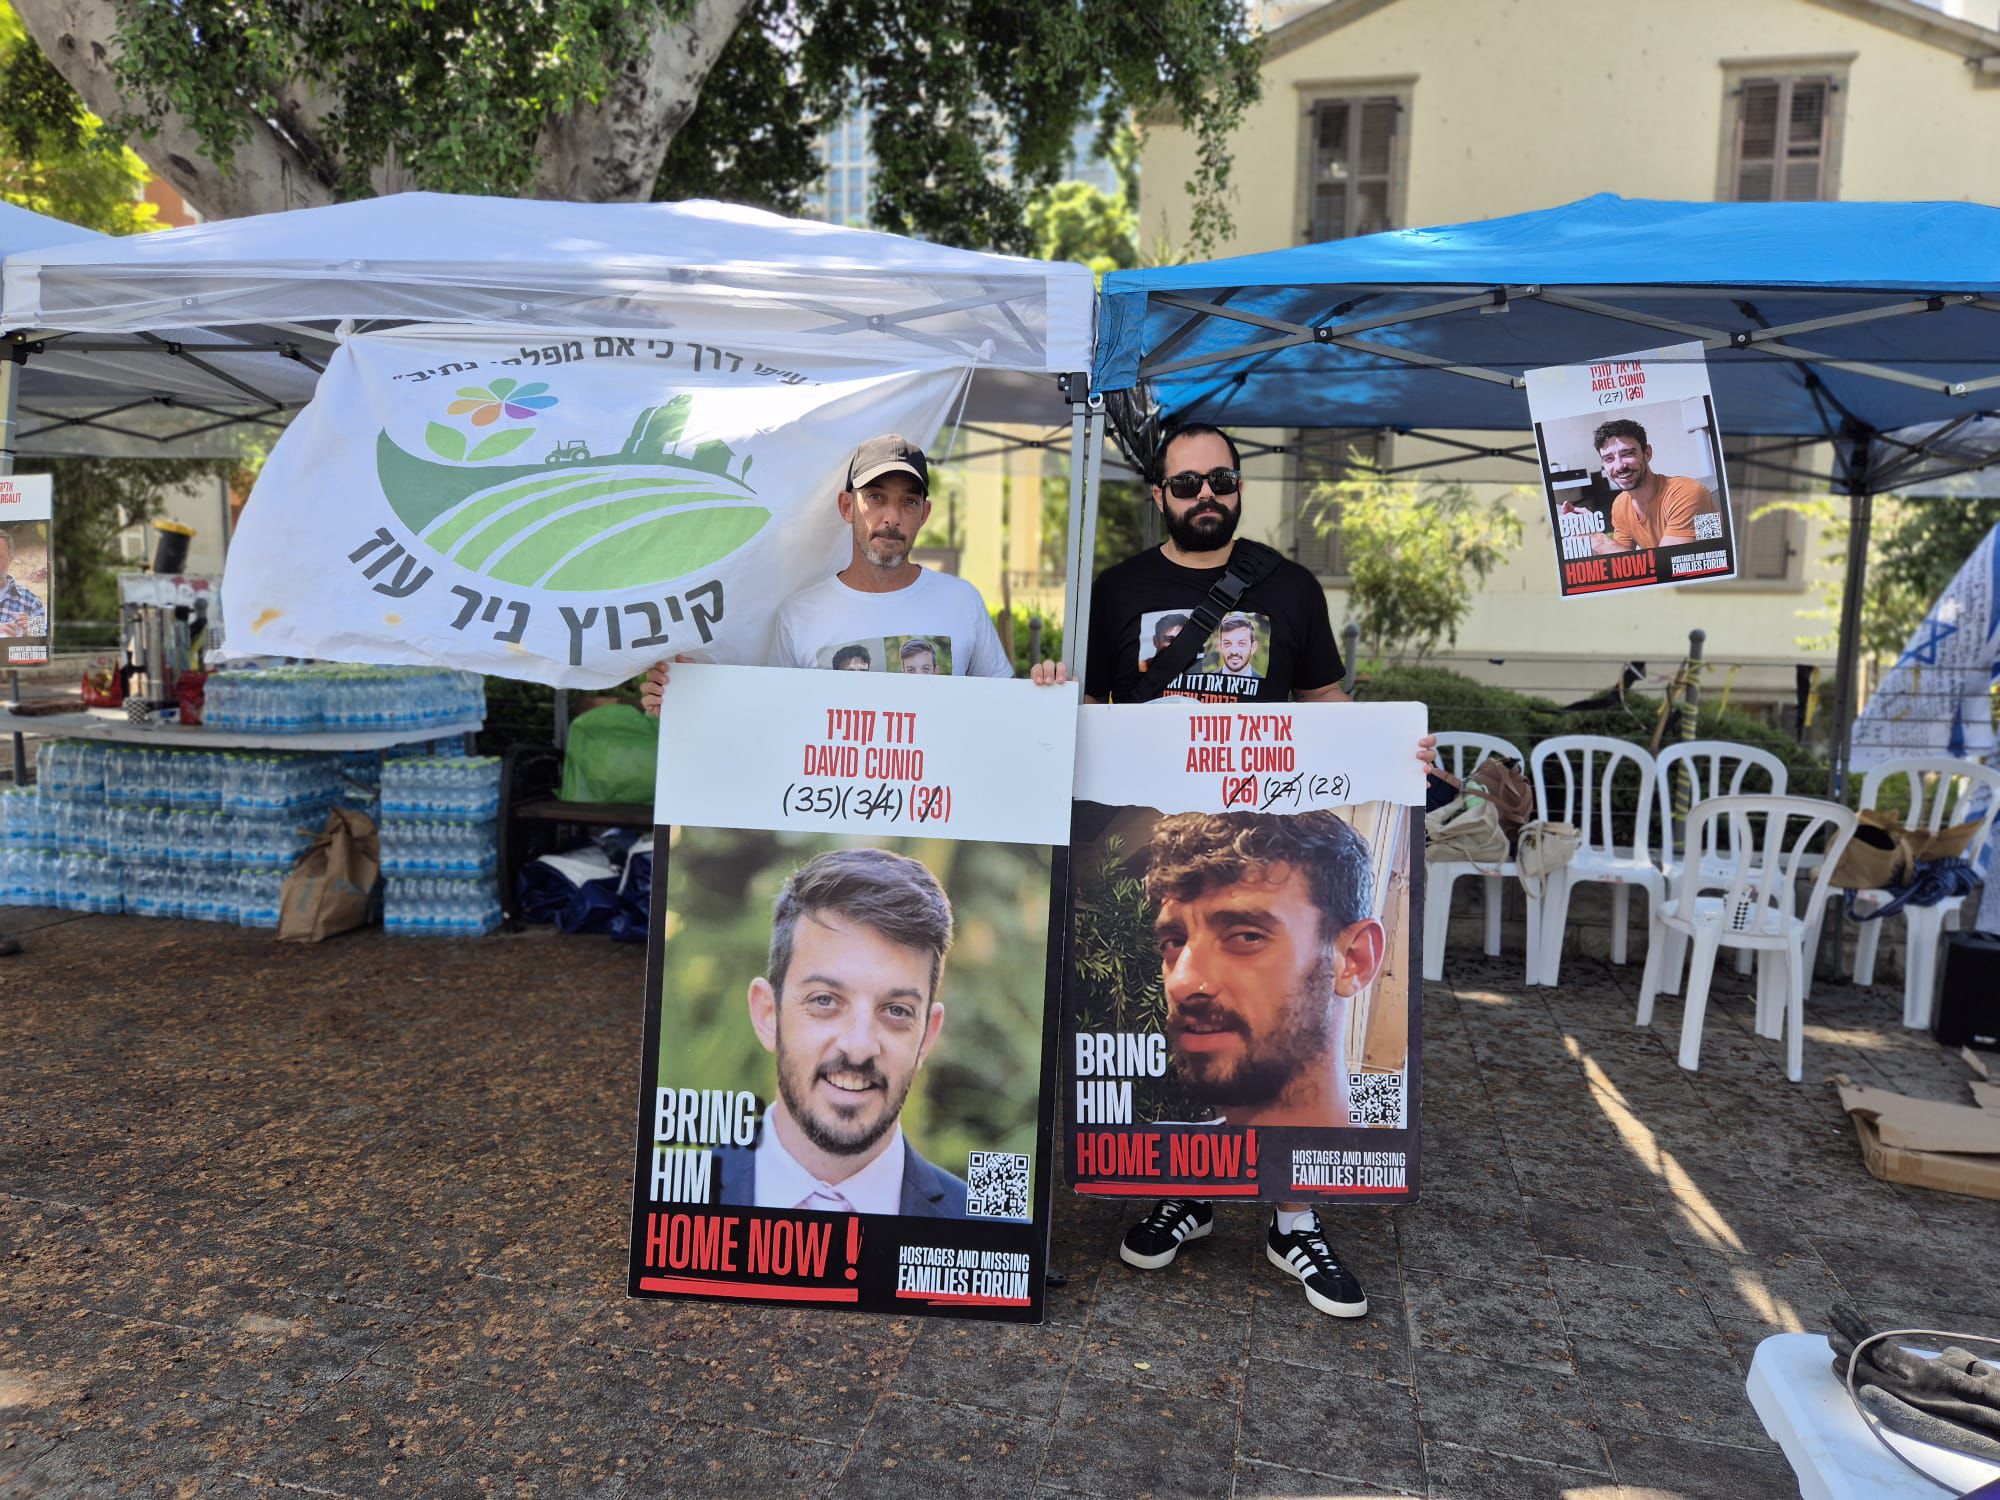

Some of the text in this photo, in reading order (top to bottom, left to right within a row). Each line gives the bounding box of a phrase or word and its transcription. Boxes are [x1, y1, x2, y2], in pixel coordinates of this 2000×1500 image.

[594, 336, 635, 357] אם
[648, 340, 674, 359] כי
[687, 343, 743, 372] דרך
[1592, 372, 1646, 392] ARIEL CUNIO
[1598, 390, 1623, 406] (27)
[1558, 511, 1606, 538] BRING
[1562, 535, 1592, 560] HIM
[1565, 549, 1657, 585] HOME NOW!
[1671, 557, 1728, 575] FAMILIES FORUM
[347, 526, 724, 667] קיבוץ ניר עוז
[1186, 674, 1204, 690] דוד
[1205, 674, 1225, 692] את
[1226, 676, 1259, 696] הביאו
[827, 708, 917, 745] דוד קוניו
[1189, 713, 1293, 745] אריאל קוניו
[804, 744, 924, 781] DAVID CUNIO
[1186, 746, 1295, 773] ARIEL CUNIO
[1309, 773, 1350, 802] (28)
[1075, 1033, 1167, 1077] BRING
[654, 1087, 756, 1146] BRING
[1076, 1081, 1133, 1124] HIM
[1077, 1129, 1260, 1179] HOME NOW!
[1292, 1150, 1406, 1167] HOSTAGES AND MISSING
[650, 1148, 713, 1205] HIM
[1292, 1165, 1406, 1188] FAMILIES FORUM
[645, 1213, 740, 1273] HOME
[900, 1246, 1031, 1273] HOSTAGES AND MISSING
[897, 1265, 1030, 1300] FAMILIES FORUM
